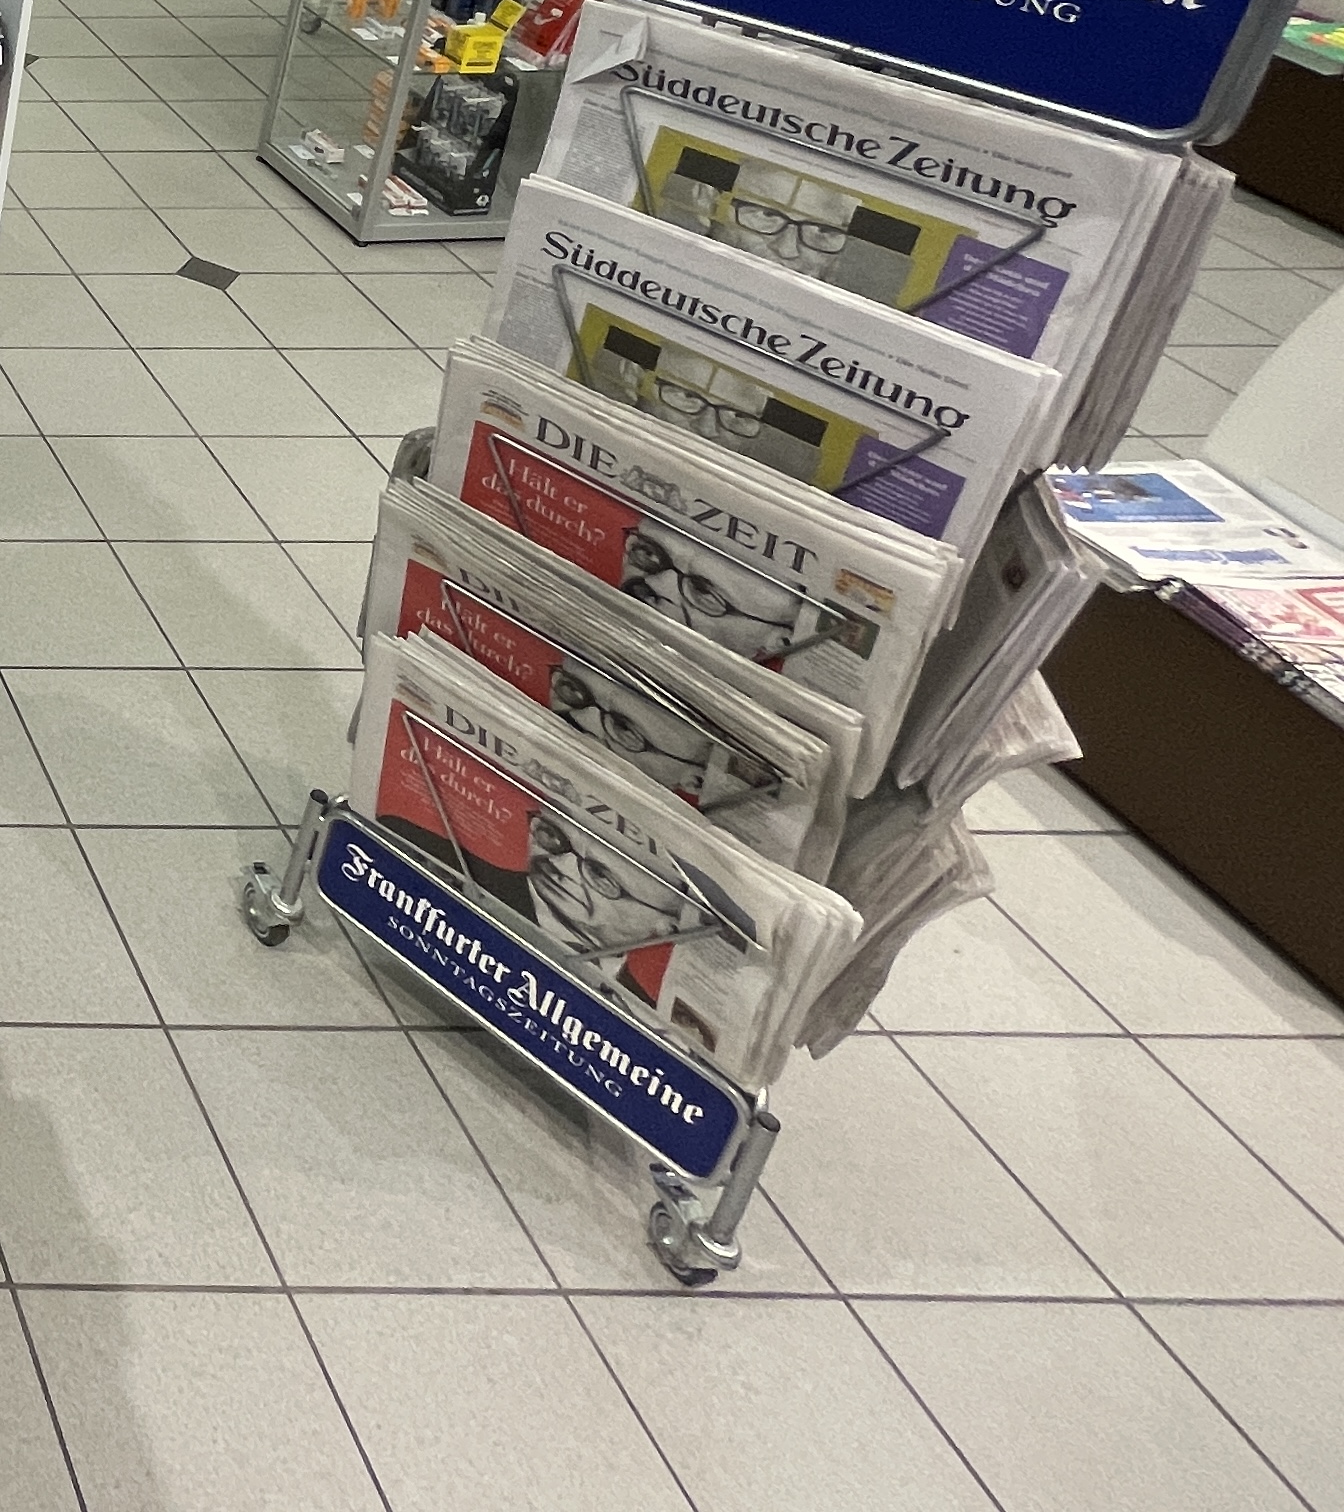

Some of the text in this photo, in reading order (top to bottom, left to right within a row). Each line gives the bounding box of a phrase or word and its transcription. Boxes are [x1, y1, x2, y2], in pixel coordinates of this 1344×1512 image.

[612, 55, 1078, 230] Süddeutsche Zeitung
[541, 229, 971, 434] Süddeutsche Zeitung
[525, 490, 607, 546] durch?
[534, 413, 818, 576] DIE ZEIT
[562, 491, 589, 517] er
[489, 626, 519, 651] er
[443, 703, 519, 765] DIE
[469, 767, 495, 796] er
[339, 841, 705, 1127] Frankfurter Allgemeine
[384, 915, 623, 1100] SONNTAGSZEITUNG
